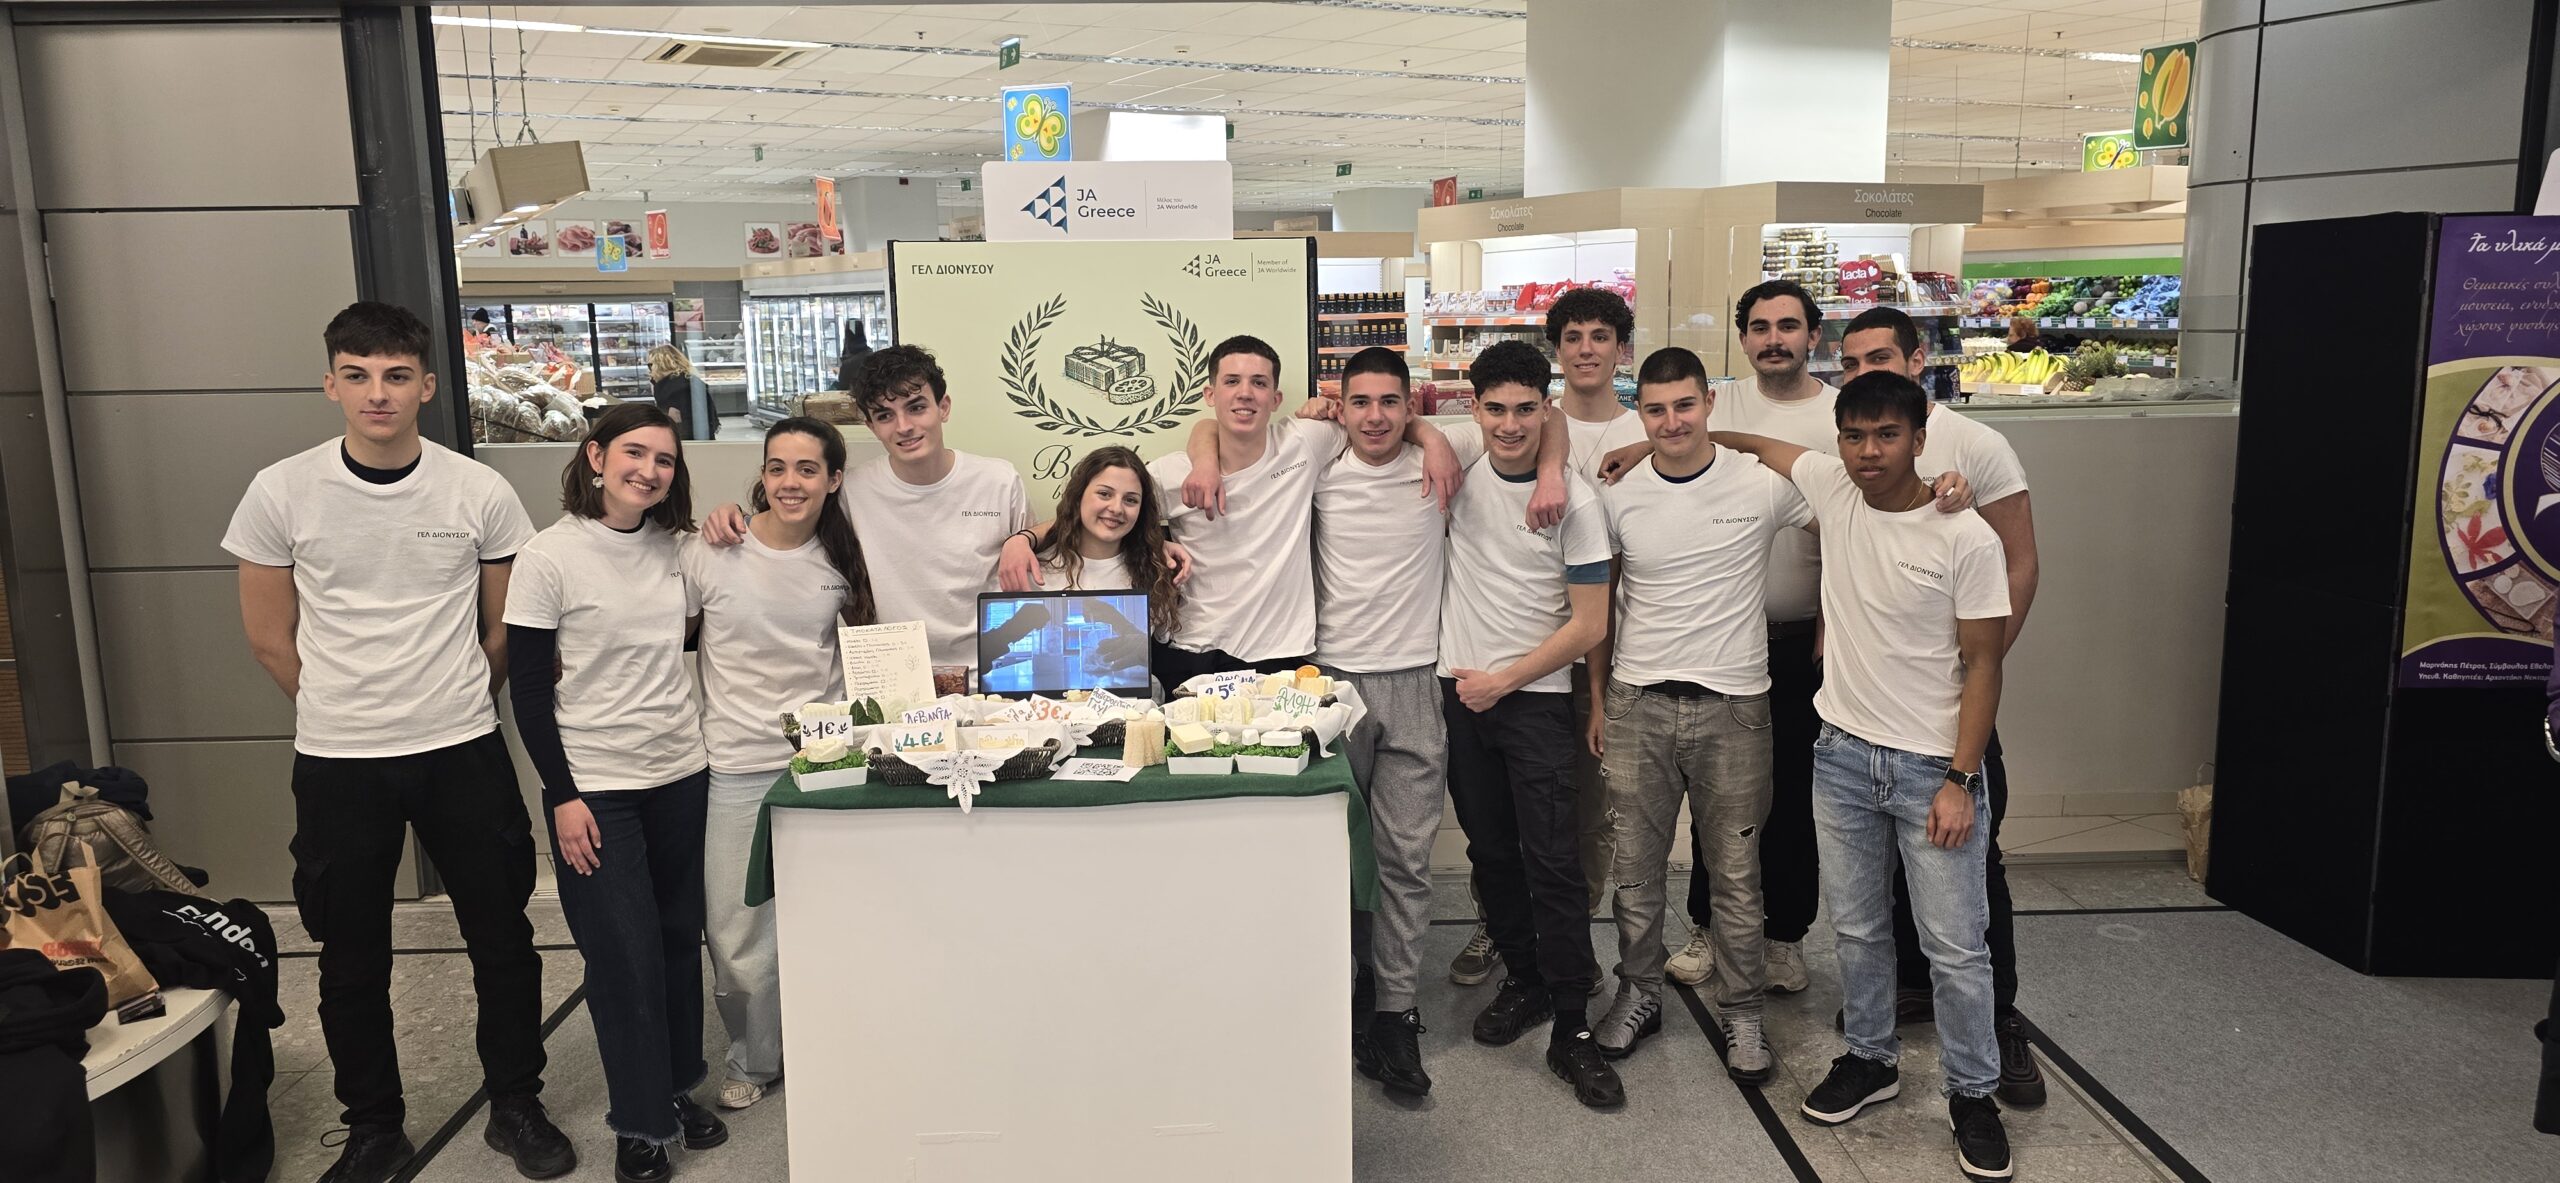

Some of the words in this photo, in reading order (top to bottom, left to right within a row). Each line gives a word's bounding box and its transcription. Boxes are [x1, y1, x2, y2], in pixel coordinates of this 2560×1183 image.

[1076, 188, 1098, 202] JA
[1854, 188, 1914, 206] Σοκολάτες
[1077, 205, 1136, 218] Greece
[1490, 203, 1534, 220] Σοκολάτες
[1865, 208, 1903, 218] Chocolate
[1497, 222, 1525, 233] Chocolate
[2468, 232, 2492, 253] Τα
[1204, 254, 1221, 265] JA
[911, 264, 933, 275] ΓΕΛ
[936, 264, 994, 275] ΔΙΟΝΥΣΟΥ
[1204, 266, 1247, 277] Greece
[1270, 472, 1281, 480] ΓΕΛ
[1281, 459, 1308, 476] ΔΙΟΝΥΣΟΥ
[1725, 516, 1760, 524] ΔΙΟΝΥΣΟΥ
[417, 531, 430, 539] ΓΕΛ
[432, 531, 470, 539] ΔΙΟΝΥΣΟΥ
[1897, 560, 1909, 570] ΓΕΛ
[1910, 564, 1944, 581] ΔΙΟΝΥΣΟΥ
[2419, 661, 2458, 670] Μαρινάκης
[902, 731, 933, 748] 4€
